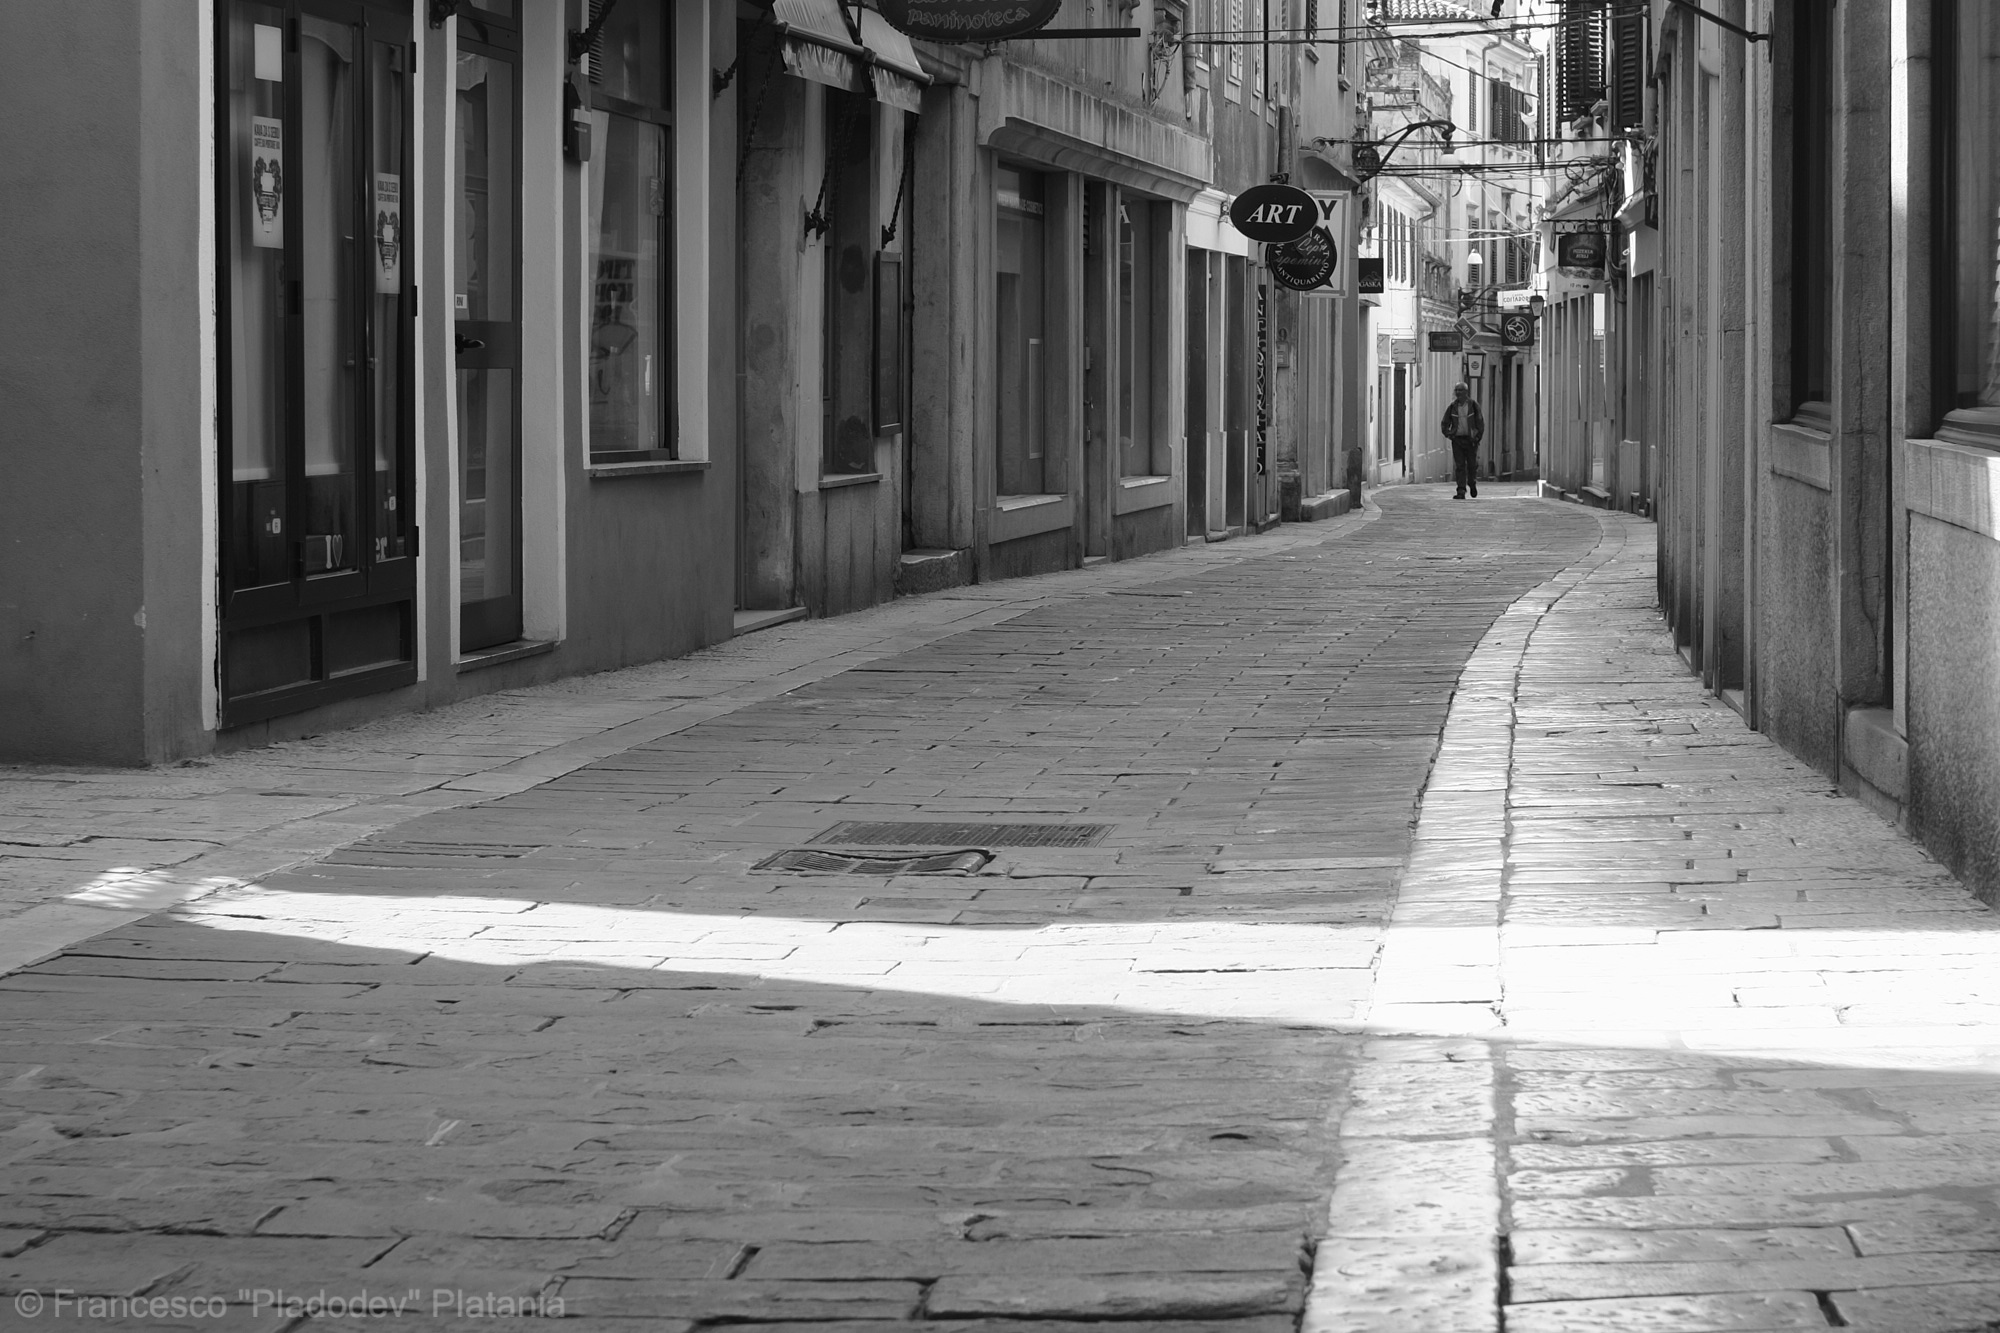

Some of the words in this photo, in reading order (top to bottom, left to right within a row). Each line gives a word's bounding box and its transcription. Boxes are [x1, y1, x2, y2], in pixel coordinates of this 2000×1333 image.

[1246, 203, 1303, 225] ART
[1318, 200, 1337, 220] Y
[1277, 262, 1330, 286] ANTIQUARIATO
[1278, 327, 1288, 341] 9
